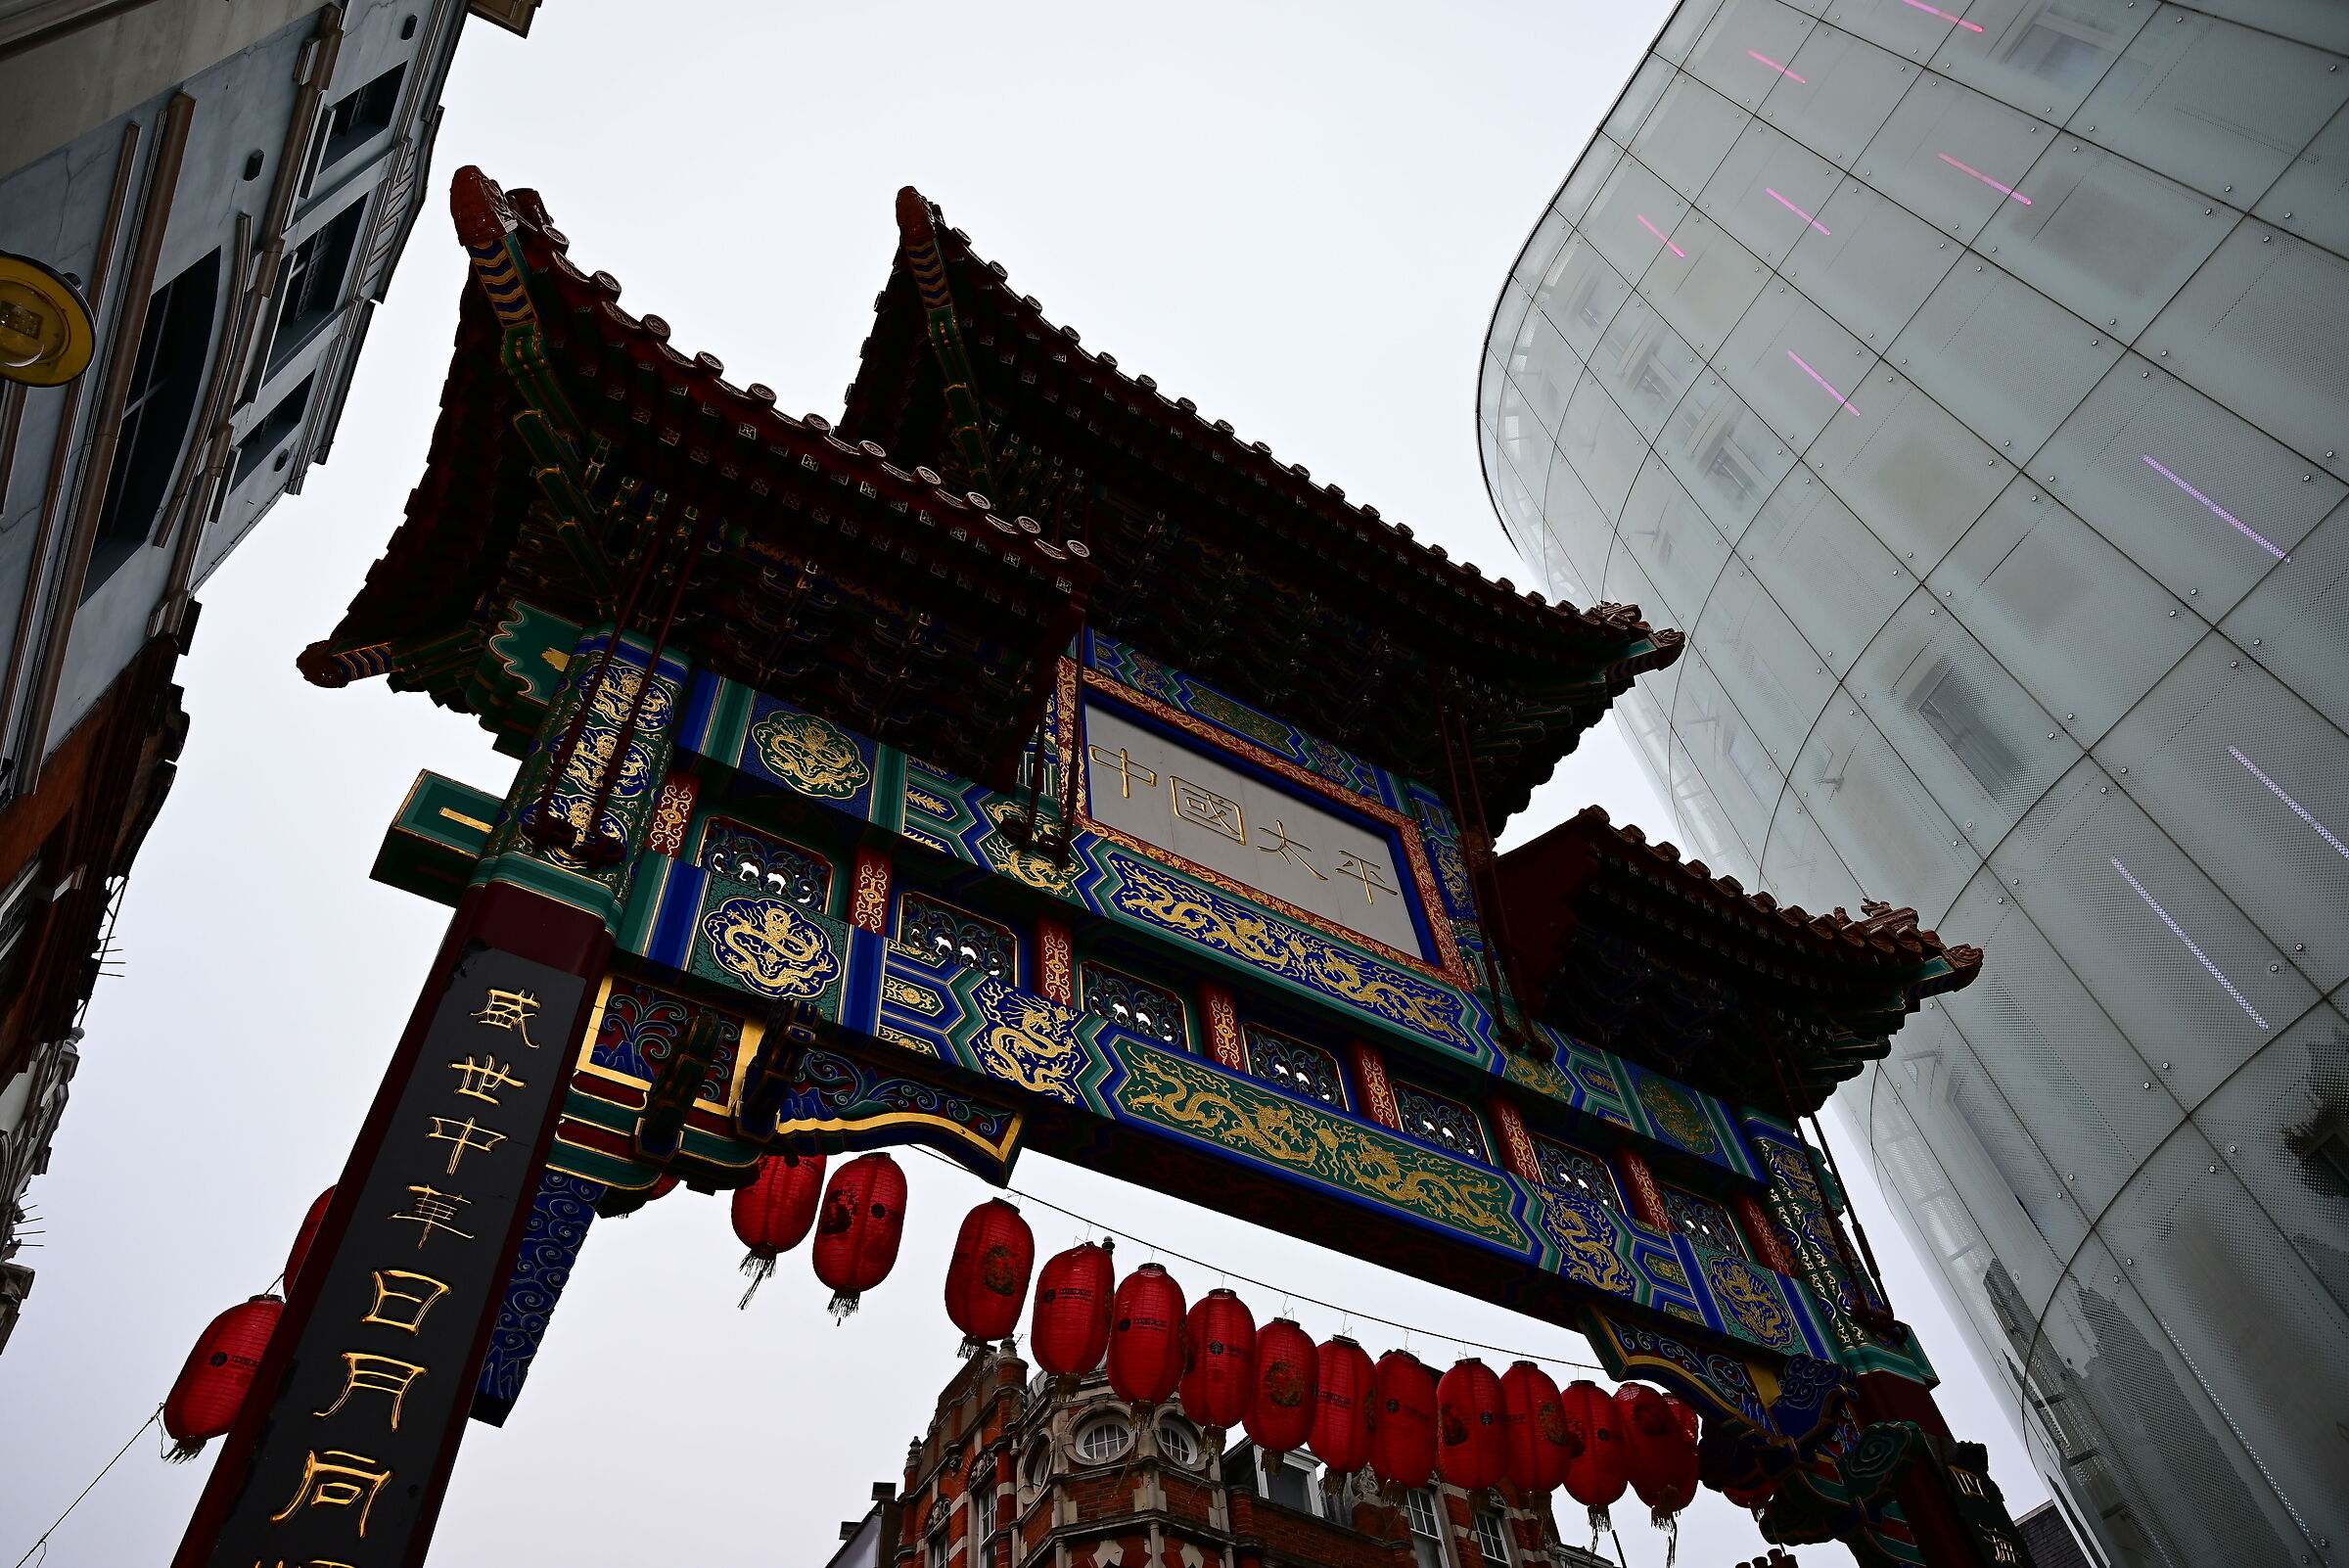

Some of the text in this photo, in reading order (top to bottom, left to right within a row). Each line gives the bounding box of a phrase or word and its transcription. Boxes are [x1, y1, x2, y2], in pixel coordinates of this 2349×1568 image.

[1087, 744, 1399, 904] 中國太平
[253, 988, 541, 1568] 盛世中華日月同
